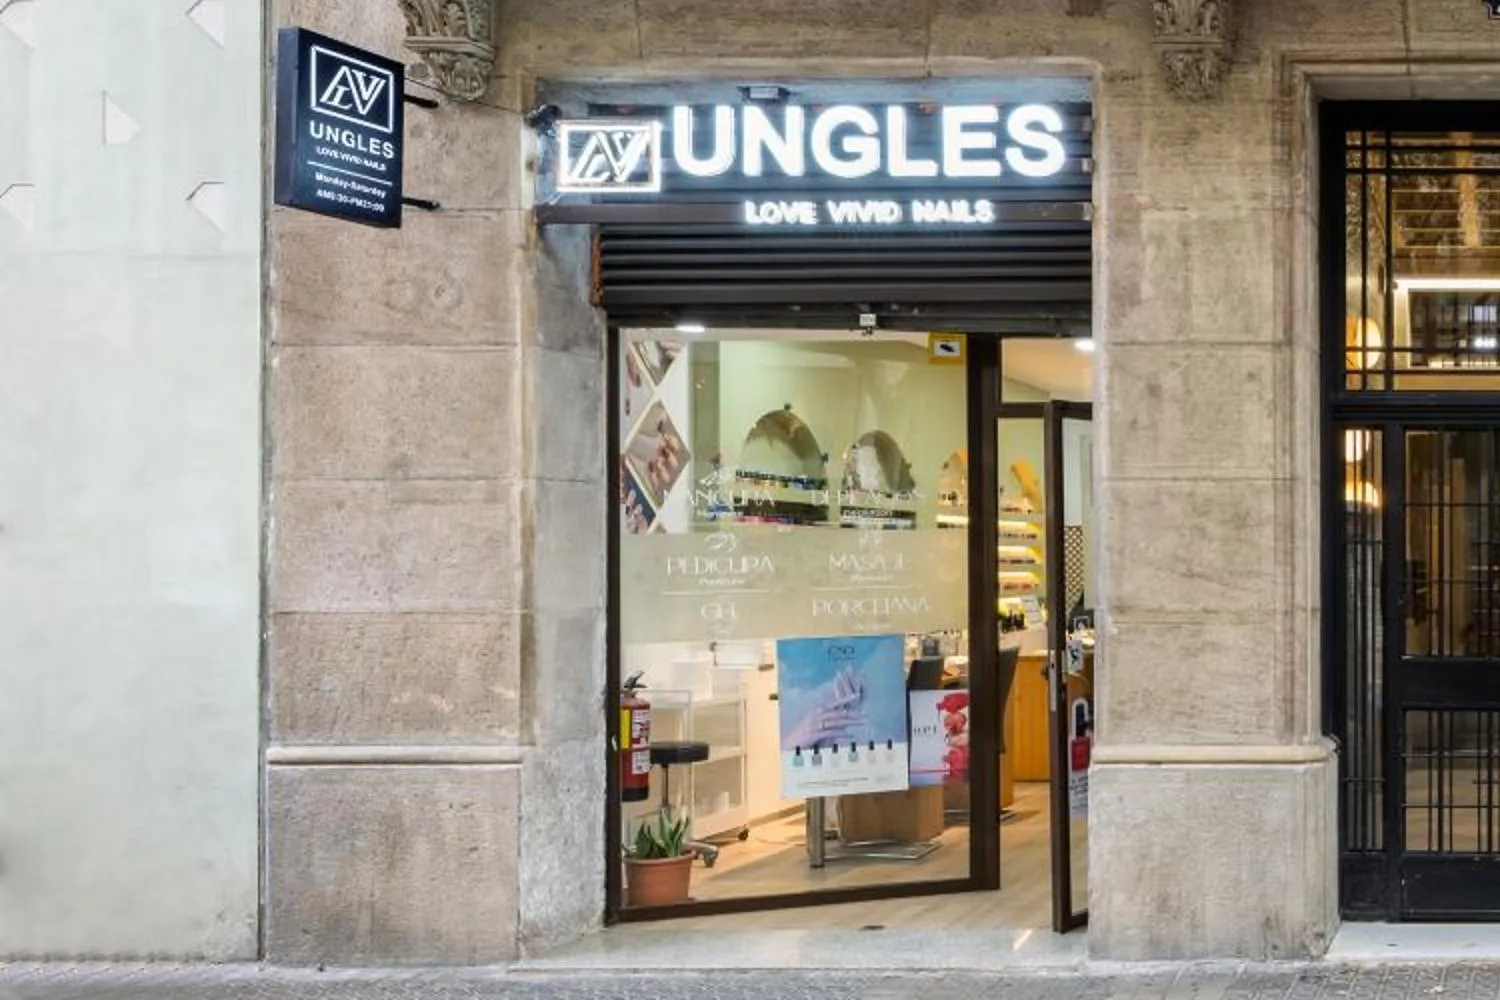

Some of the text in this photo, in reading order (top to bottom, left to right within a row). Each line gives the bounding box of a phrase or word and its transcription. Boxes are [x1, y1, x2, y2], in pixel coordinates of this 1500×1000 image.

[309, 120, 395, 159] UNGLES
[671, 104, 1067, 178] UNGLES
[745, 200, 996, 224] LOVE VIVID NAILS
